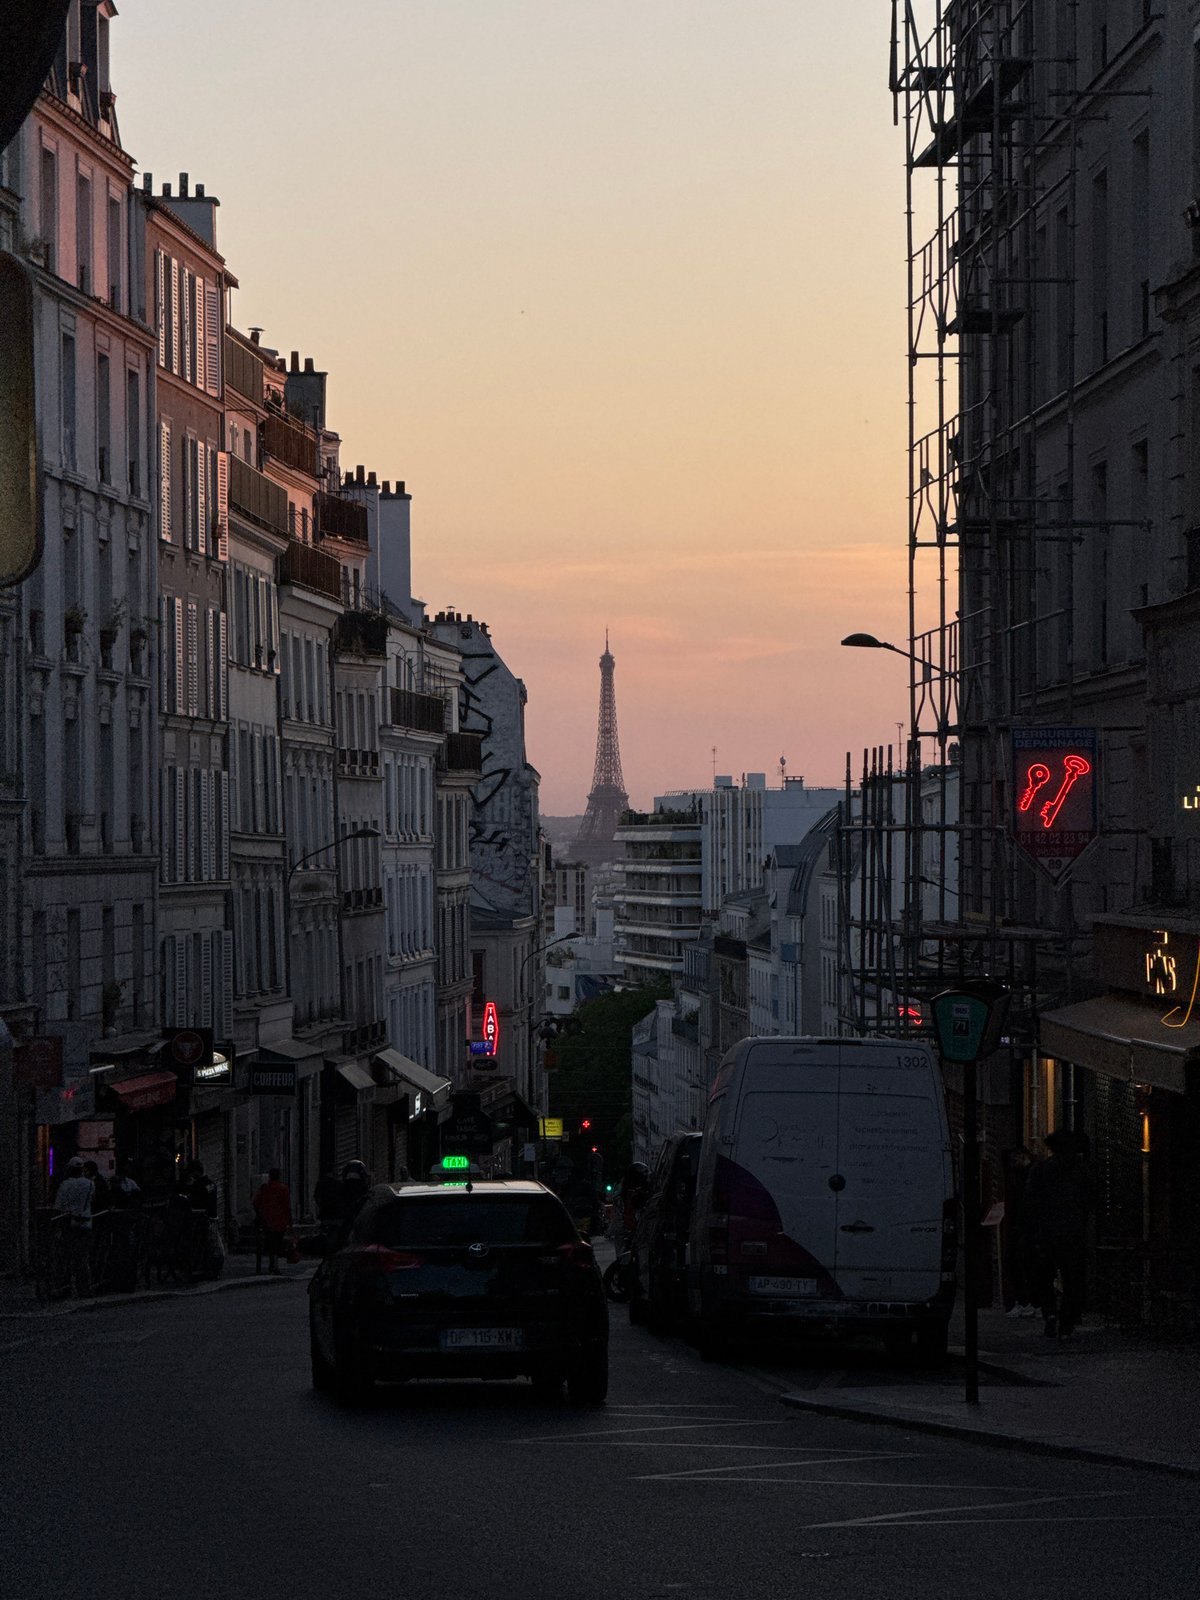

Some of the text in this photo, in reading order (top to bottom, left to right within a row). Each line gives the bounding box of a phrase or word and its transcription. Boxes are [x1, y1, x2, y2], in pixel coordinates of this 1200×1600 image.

[1014, 729, 1095, 739] SERRURERIE
[1048, 859, 1062, 870] 89
[896, 1056, 928, 1069] 1302
[254, 1071, 294, 1088] COIFFEUR
[446, 1158, 466, 1168] TAXI
